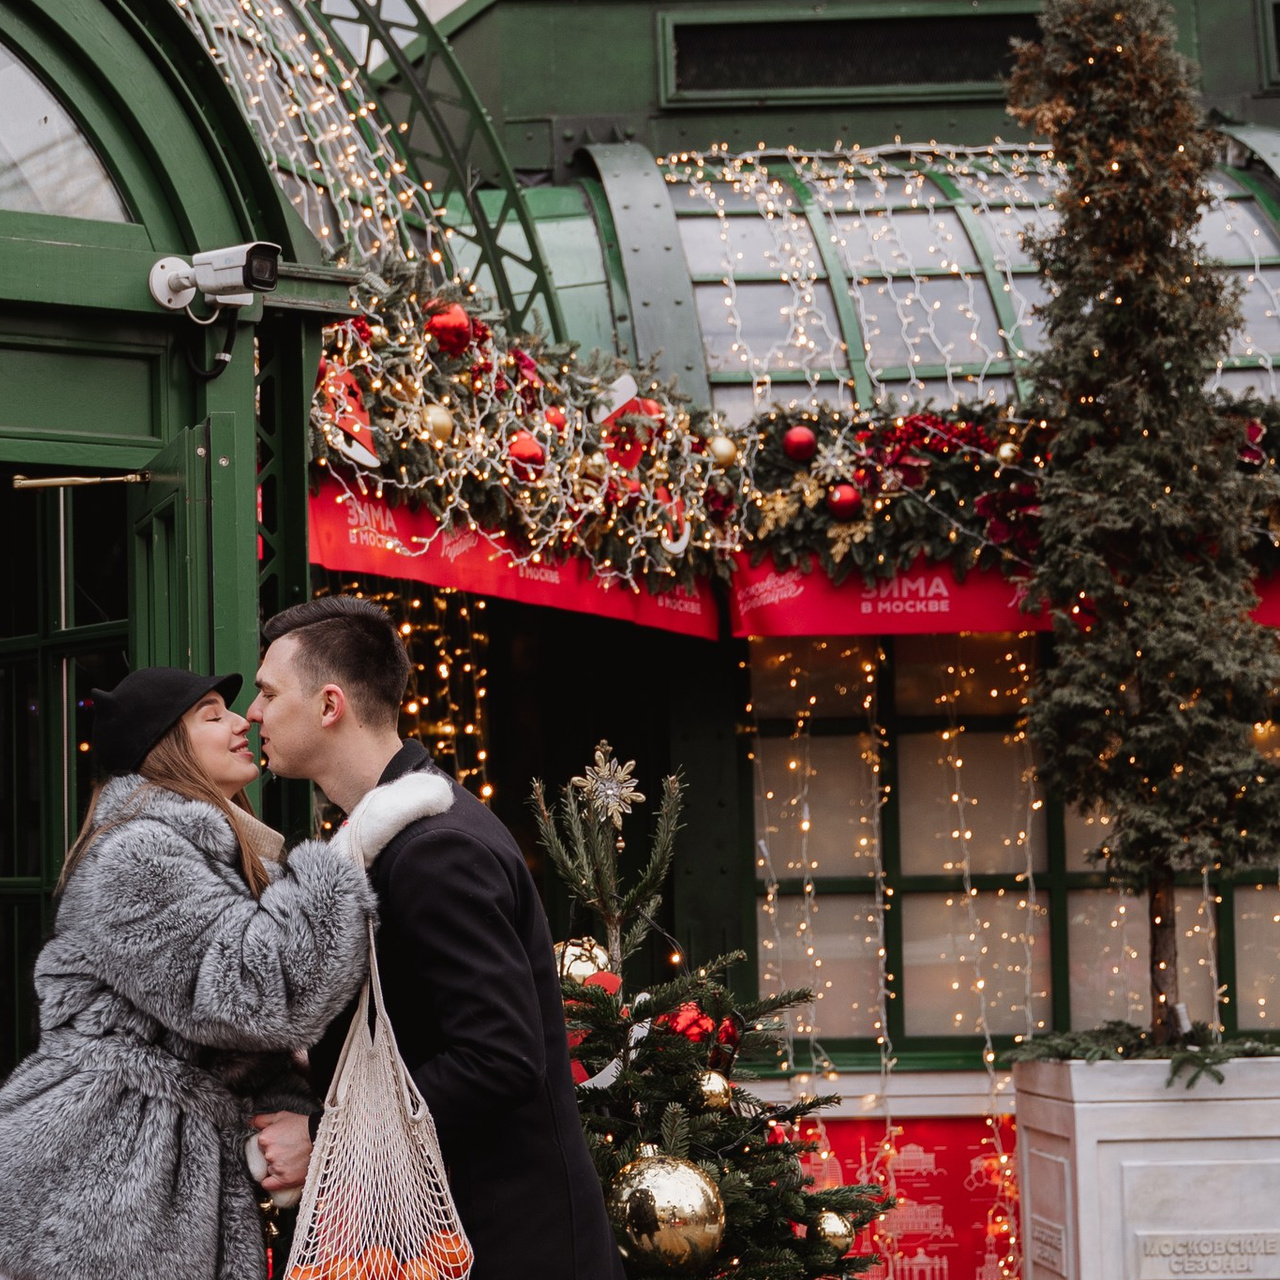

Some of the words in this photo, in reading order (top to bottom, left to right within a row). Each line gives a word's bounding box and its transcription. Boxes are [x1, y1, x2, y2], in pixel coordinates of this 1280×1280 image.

[345, 499, 398, 533] ЗИМА
[349, 529, 358, 545] В
[860, 576, 949, 600] ЗИМА
[861, 601, 872, 613] В
[877, 600, 950, 614] МОСКВЕ
[1143, 1238, 1277, 1257] МОСКОВСКИЕ
[1169, 1258, 1253, 1274] СЕЗОНЫ
